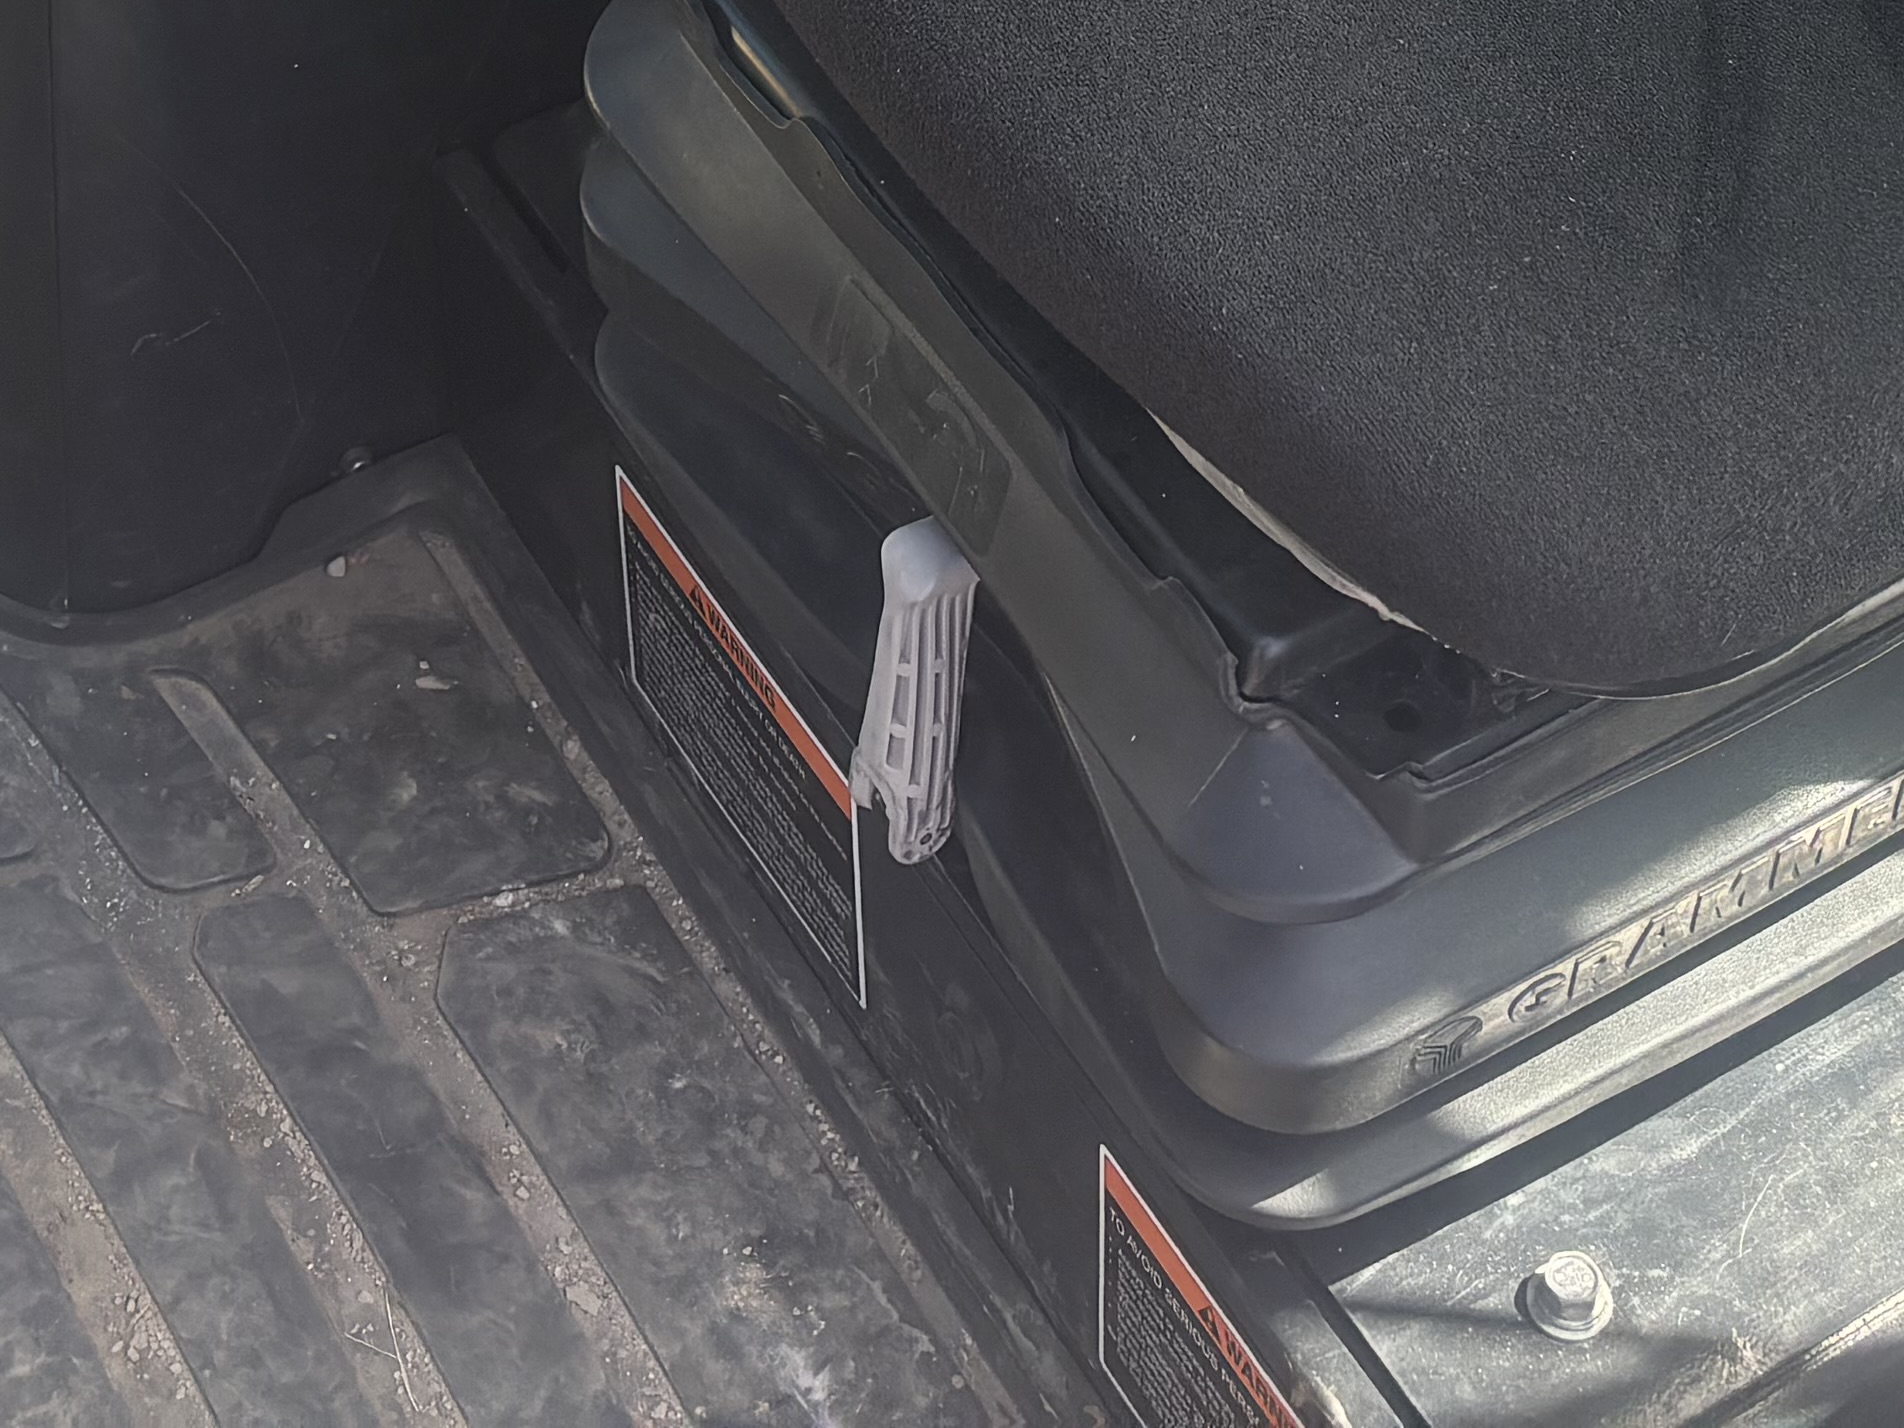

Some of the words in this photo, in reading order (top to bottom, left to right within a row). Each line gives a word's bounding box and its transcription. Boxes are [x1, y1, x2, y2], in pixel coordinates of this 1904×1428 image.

[708, 602, 776, 715] WARNING
[1109, 1206, 1126, 1237] TO
[1165, 1287, 1219, 1371] SERIOUS
